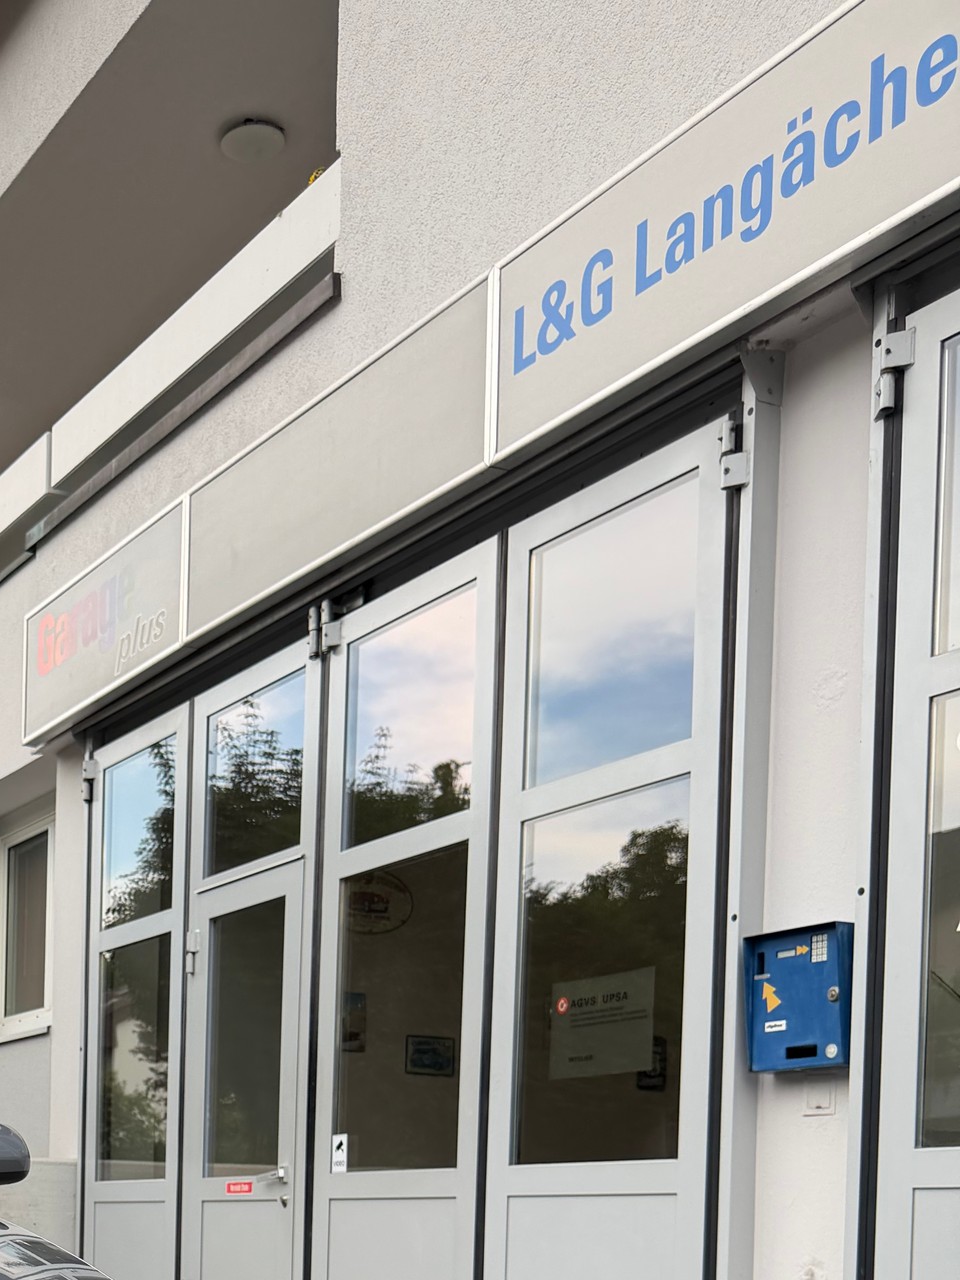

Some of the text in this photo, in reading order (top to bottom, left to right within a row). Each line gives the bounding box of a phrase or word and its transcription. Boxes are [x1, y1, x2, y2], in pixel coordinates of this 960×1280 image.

[513, 33, 958, 377] L&G Langäche
[113, 607, 168, 677] plus
[570, 992, 628, 1009] AGVS UPSA
